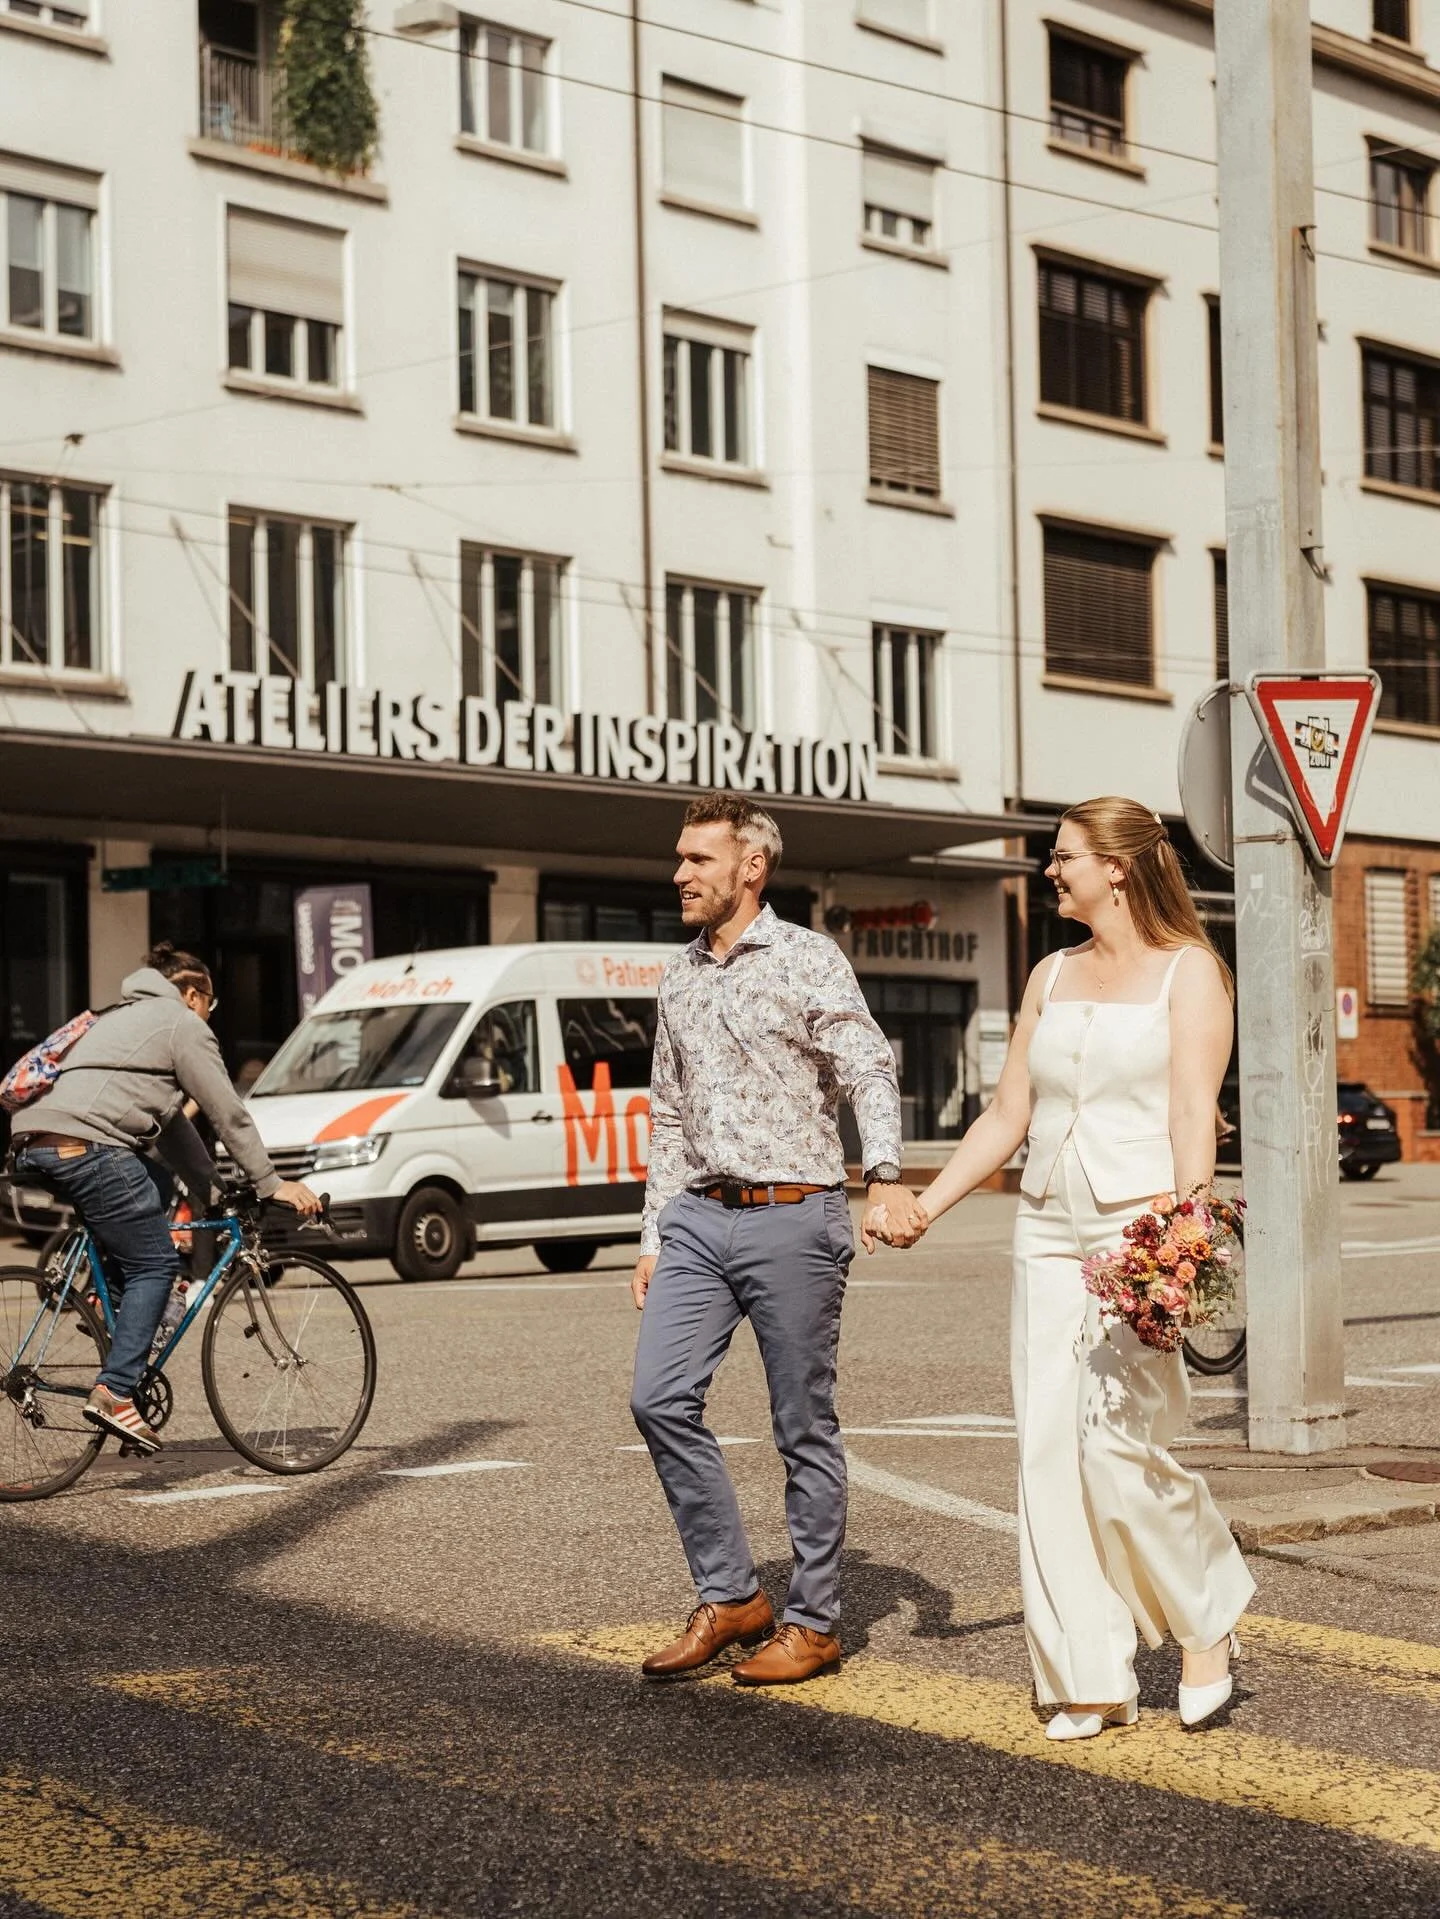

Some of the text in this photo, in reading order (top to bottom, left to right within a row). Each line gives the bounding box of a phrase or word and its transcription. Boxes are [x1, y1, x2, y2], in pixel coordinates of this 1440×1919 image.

[176, 672, 877, 801] ATELIERS DER INSPIRATION
[852, 928, 979, 963] FRUCHTHOF
